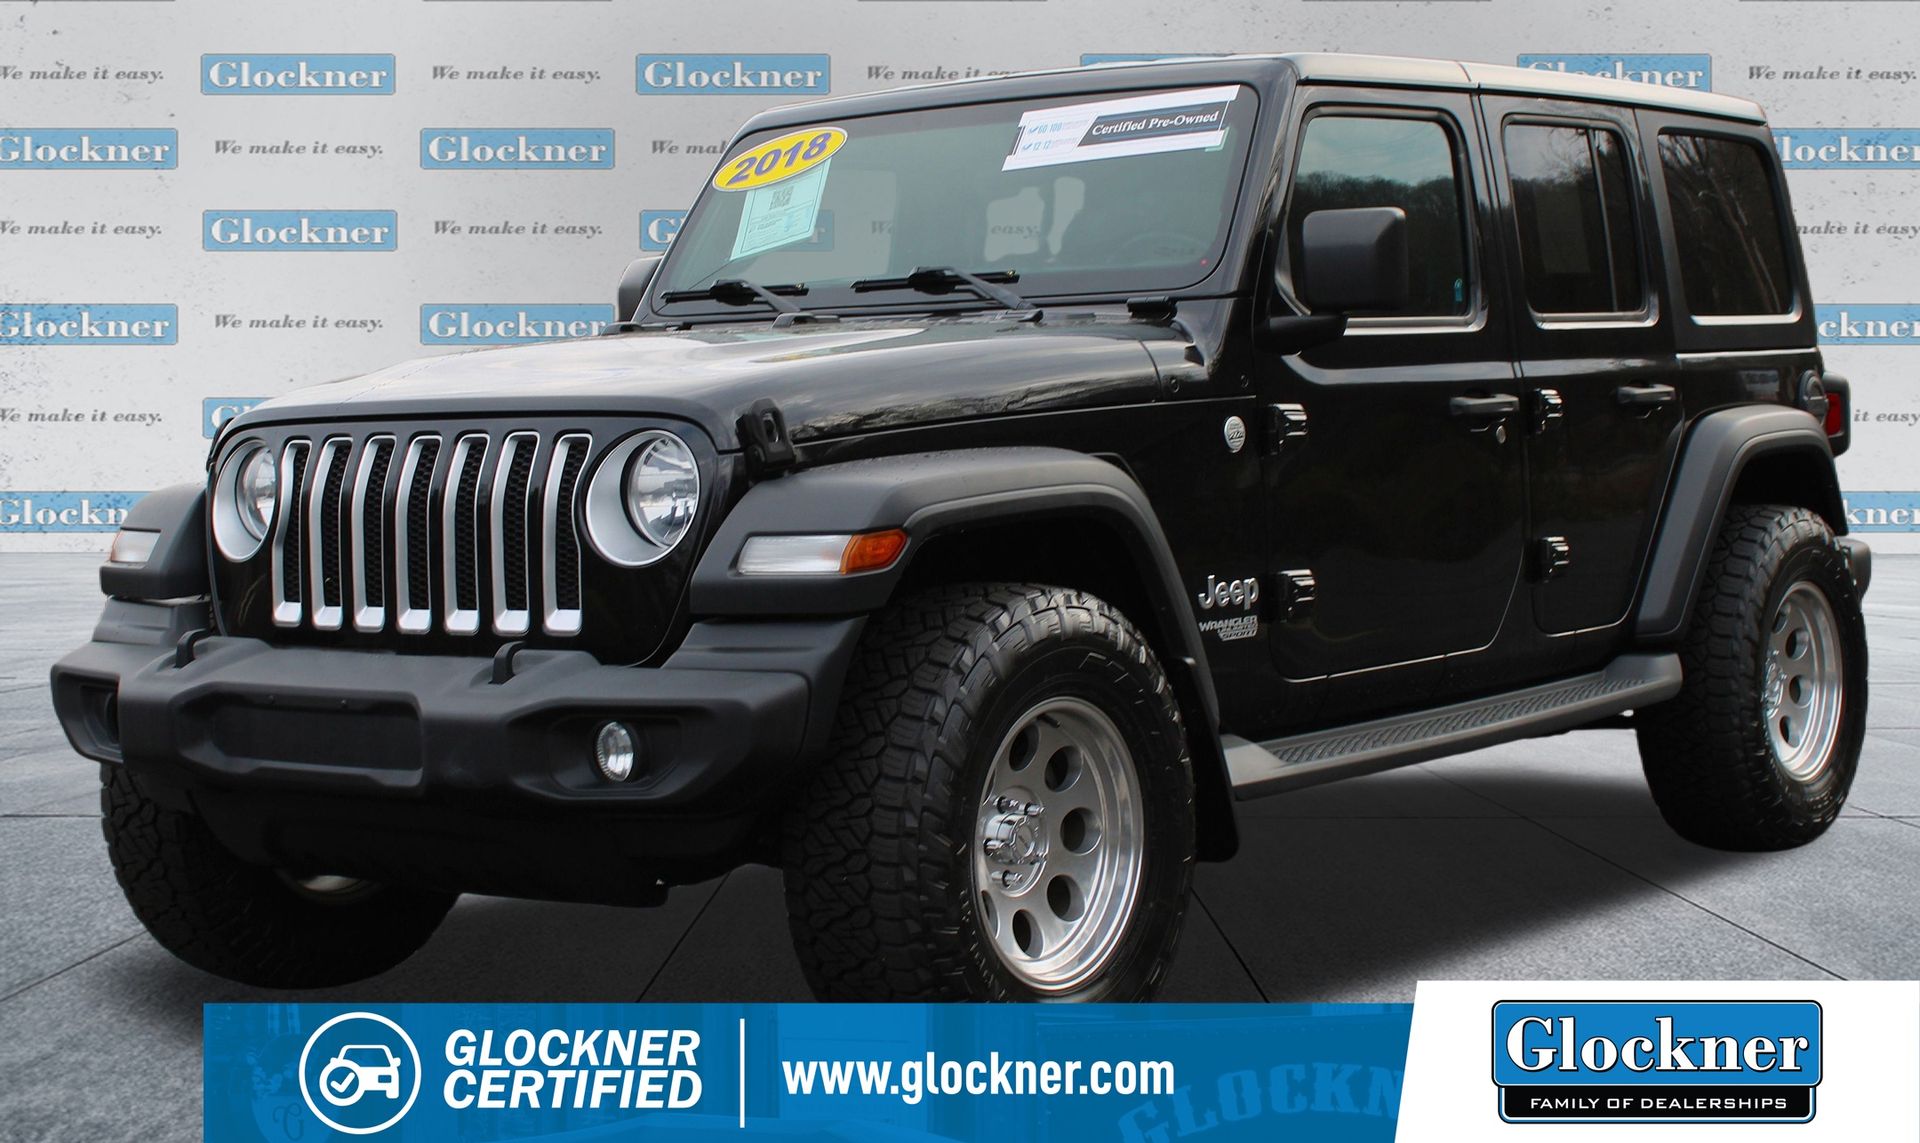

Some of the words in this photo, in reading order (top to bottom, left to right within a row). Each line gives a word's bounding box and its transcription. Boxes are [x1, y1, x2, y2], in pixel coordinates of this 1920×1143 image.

[29, 66, 87, 80] make
[93, 67, 109, 80] it
[115, 70, 165, 84] easy.
[209, 61, 387, 88] Glockner
[432, 65, 460, 80] We
[466, 66, 524, 80] make
[529, 67, 546, 80] it
[551, 70, 601, 84] easy.
[644, 61, 822, 88] Glockner
[867, 65, 895, 80] We
[901, 66, 960, 80] make
[965, 66, 981, 79] it
[1748, 65, 1777, 80] We
[1782, 66, 1841, 80] make
[1846, 67, 1862, 80] it
[1868, 70, 1918, 84] easy.
[1091, 118, 1146, 136] Certified
[1148, 111, 1219, 130] Pre-Owned
[0, 135, 170, 162] Glockner
[215, 139, 243, 155] We
[248, 140, 307, 155] make
[312, 142, 328, 155] it
[334, 145, 384, 159] easy.
[428, 135, 606, 162] Glockner
[651, 139, 679, 154] We
[725, 132, 832, 186] 2018
[1774, 136, 1920, 162] lockner
[27, 220, 86, 235] make
[91, 222, 107, 235] it
[113, 225, 163, 239] easy.
[211, 217, 389, 244] Glockner
[434, 220, 462, 235] We
[468, 220, 526, 235] make
[531, 222, 547, 235] it
[553, 225, 603, 239] easy.
[1853, 221, 1869, 235] it
[0, 311, 170, 338] Glockner
[215, 314, 243, 329] We
[248, 314, 307, 329] make
[312, 316, 328, 329] it
[334, 319, 384, 334] easy.
[428, 311, 606, 338] Glockner
[1818, 311, 1920, 338] ckner
[27, 408, 86, 423] make
[91, 409, 107, 423] it
[113, 412, 163, 427] easy.
[1853, 409, 1870, 423] it
[0, 498, 129, 526] Glockn
[1843, 498, 1920, 526] kner
[1197, 574, 1260, 611] Jeep
[1198, 615, 1259, 632] WRANGLER
